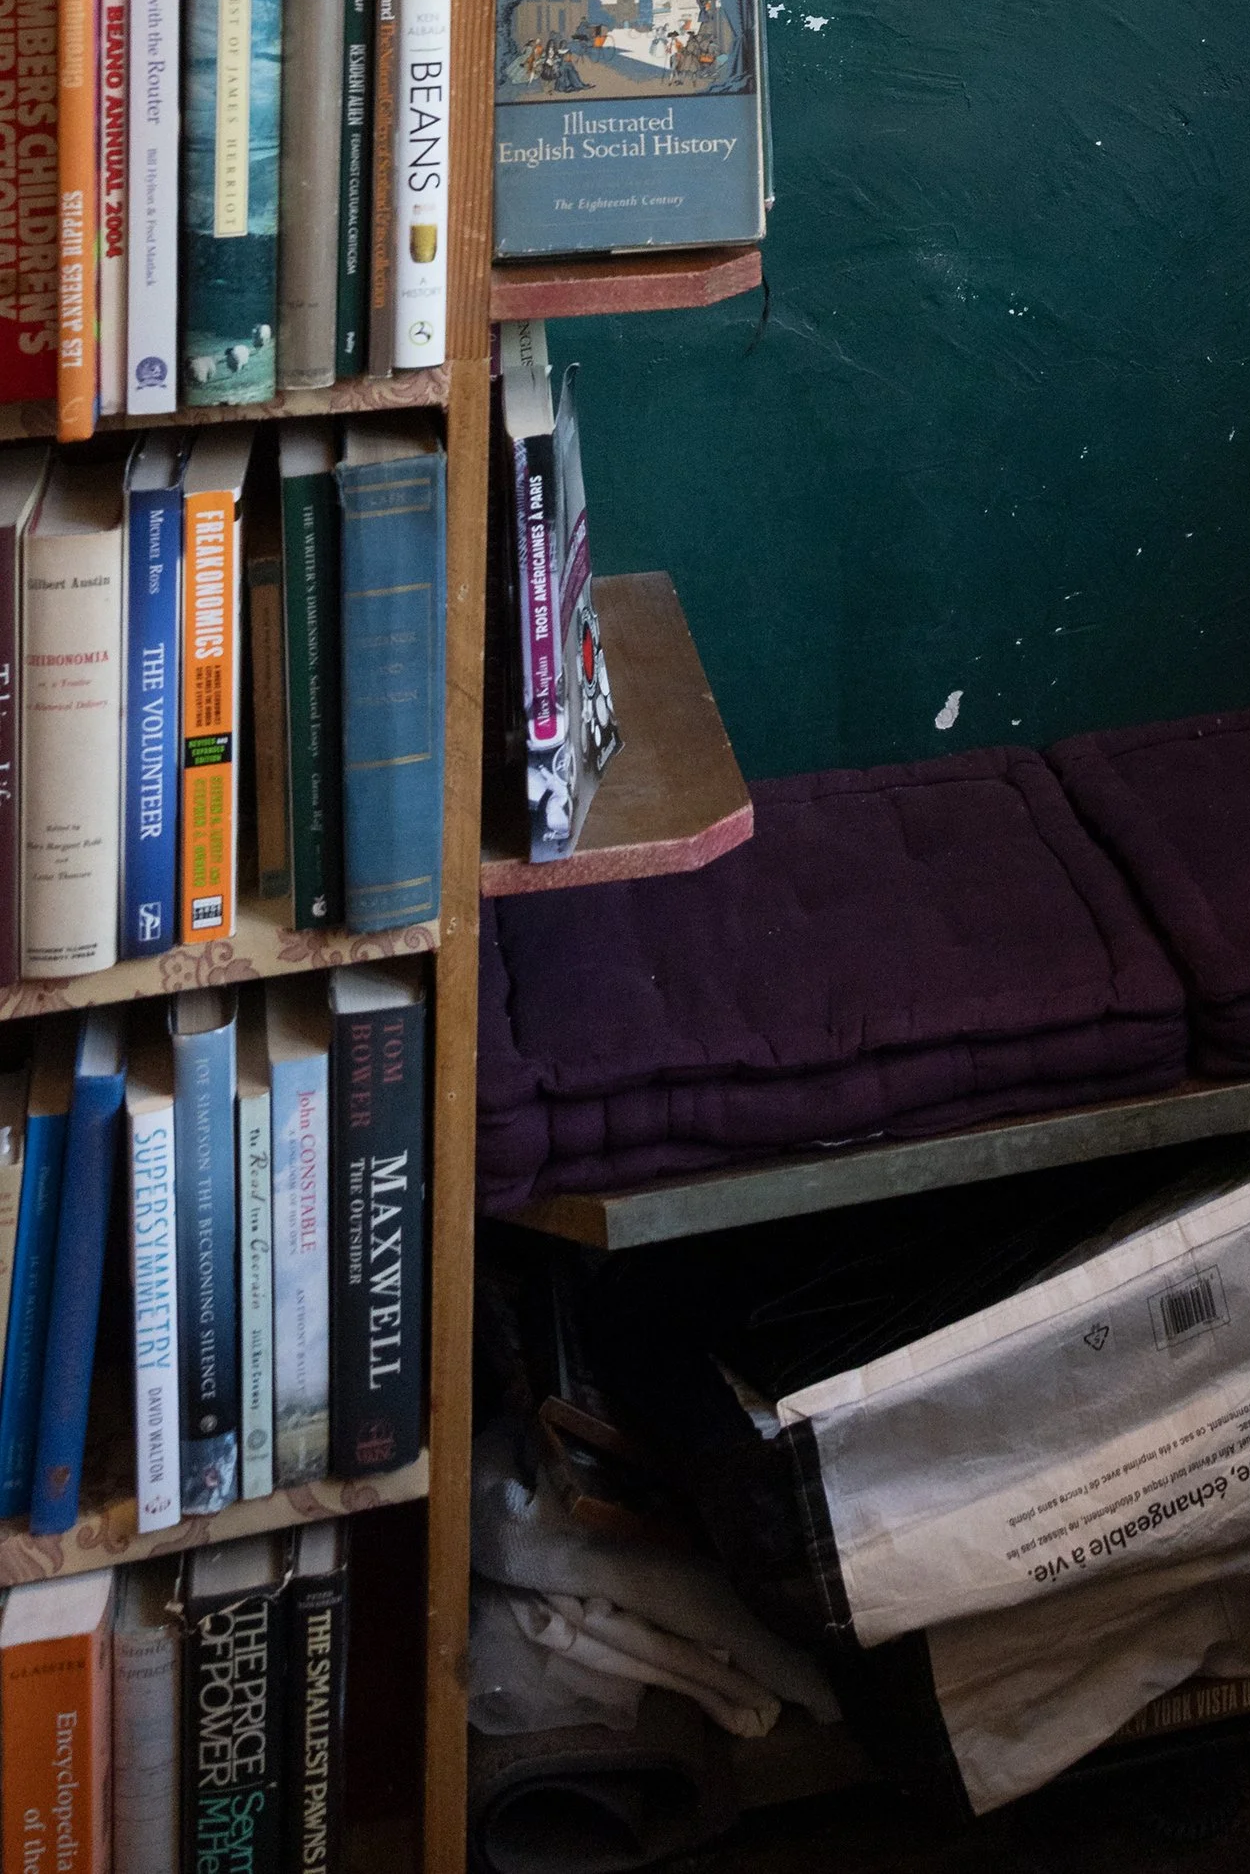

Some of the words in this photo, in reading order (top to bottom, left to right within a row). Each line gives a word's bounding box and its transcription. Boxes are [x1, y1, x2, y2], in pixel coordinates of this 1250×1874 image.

[103, 5, 124, 96] BEANO
[148, 57, 161, 125] Router
[562, 107, 674, 136] Illustrated
[104, 101, 126, 190] ANNUAL
[408, 61, 443, 192] BEANS
[499, 137, 575, 169] English
[582, 135, 646, 160] Social
[654, 135, 737, 163] History
[104, 195, 122, 259] 2004
[553, 198, 574, 211] The
[578, 194, 637, 211] Eighteenth
[641, 194, 685, 210] Century
[530, 476, 543, 509] PARIS
[530, 510, 543, 523] À
[194, 510, 225, 660] FREAKONOMICS
[530, 524, 548, 600] AMÉRICAINES
[535, 602, 548, 642] TROIS
[142, 643, 164, 693] THE
[140, 701, 163, 841] VOLUNTEER
[350, 1158, 366, 1196] THE
[349, 1199, 366, 1287] OUTSIDER
[368, 1150, 409, 1391] MAXWELL
[1089, 1476, 1227, 1555] échangeable
[1027, 1555, 1069, 1582] vie.
[1070, 1546, 1086, 1568] à
[233, 1603, 268, 1661] THE
[307, 1610, 331, 1656] THE
[231, 1687, 267, 1783] PRICE
[304, 1658, 331, 1778] SMALLEST
[55, 1711, 79, 1872] Encyclopedia
[302, 1782, 329, 1862] PAWNS
